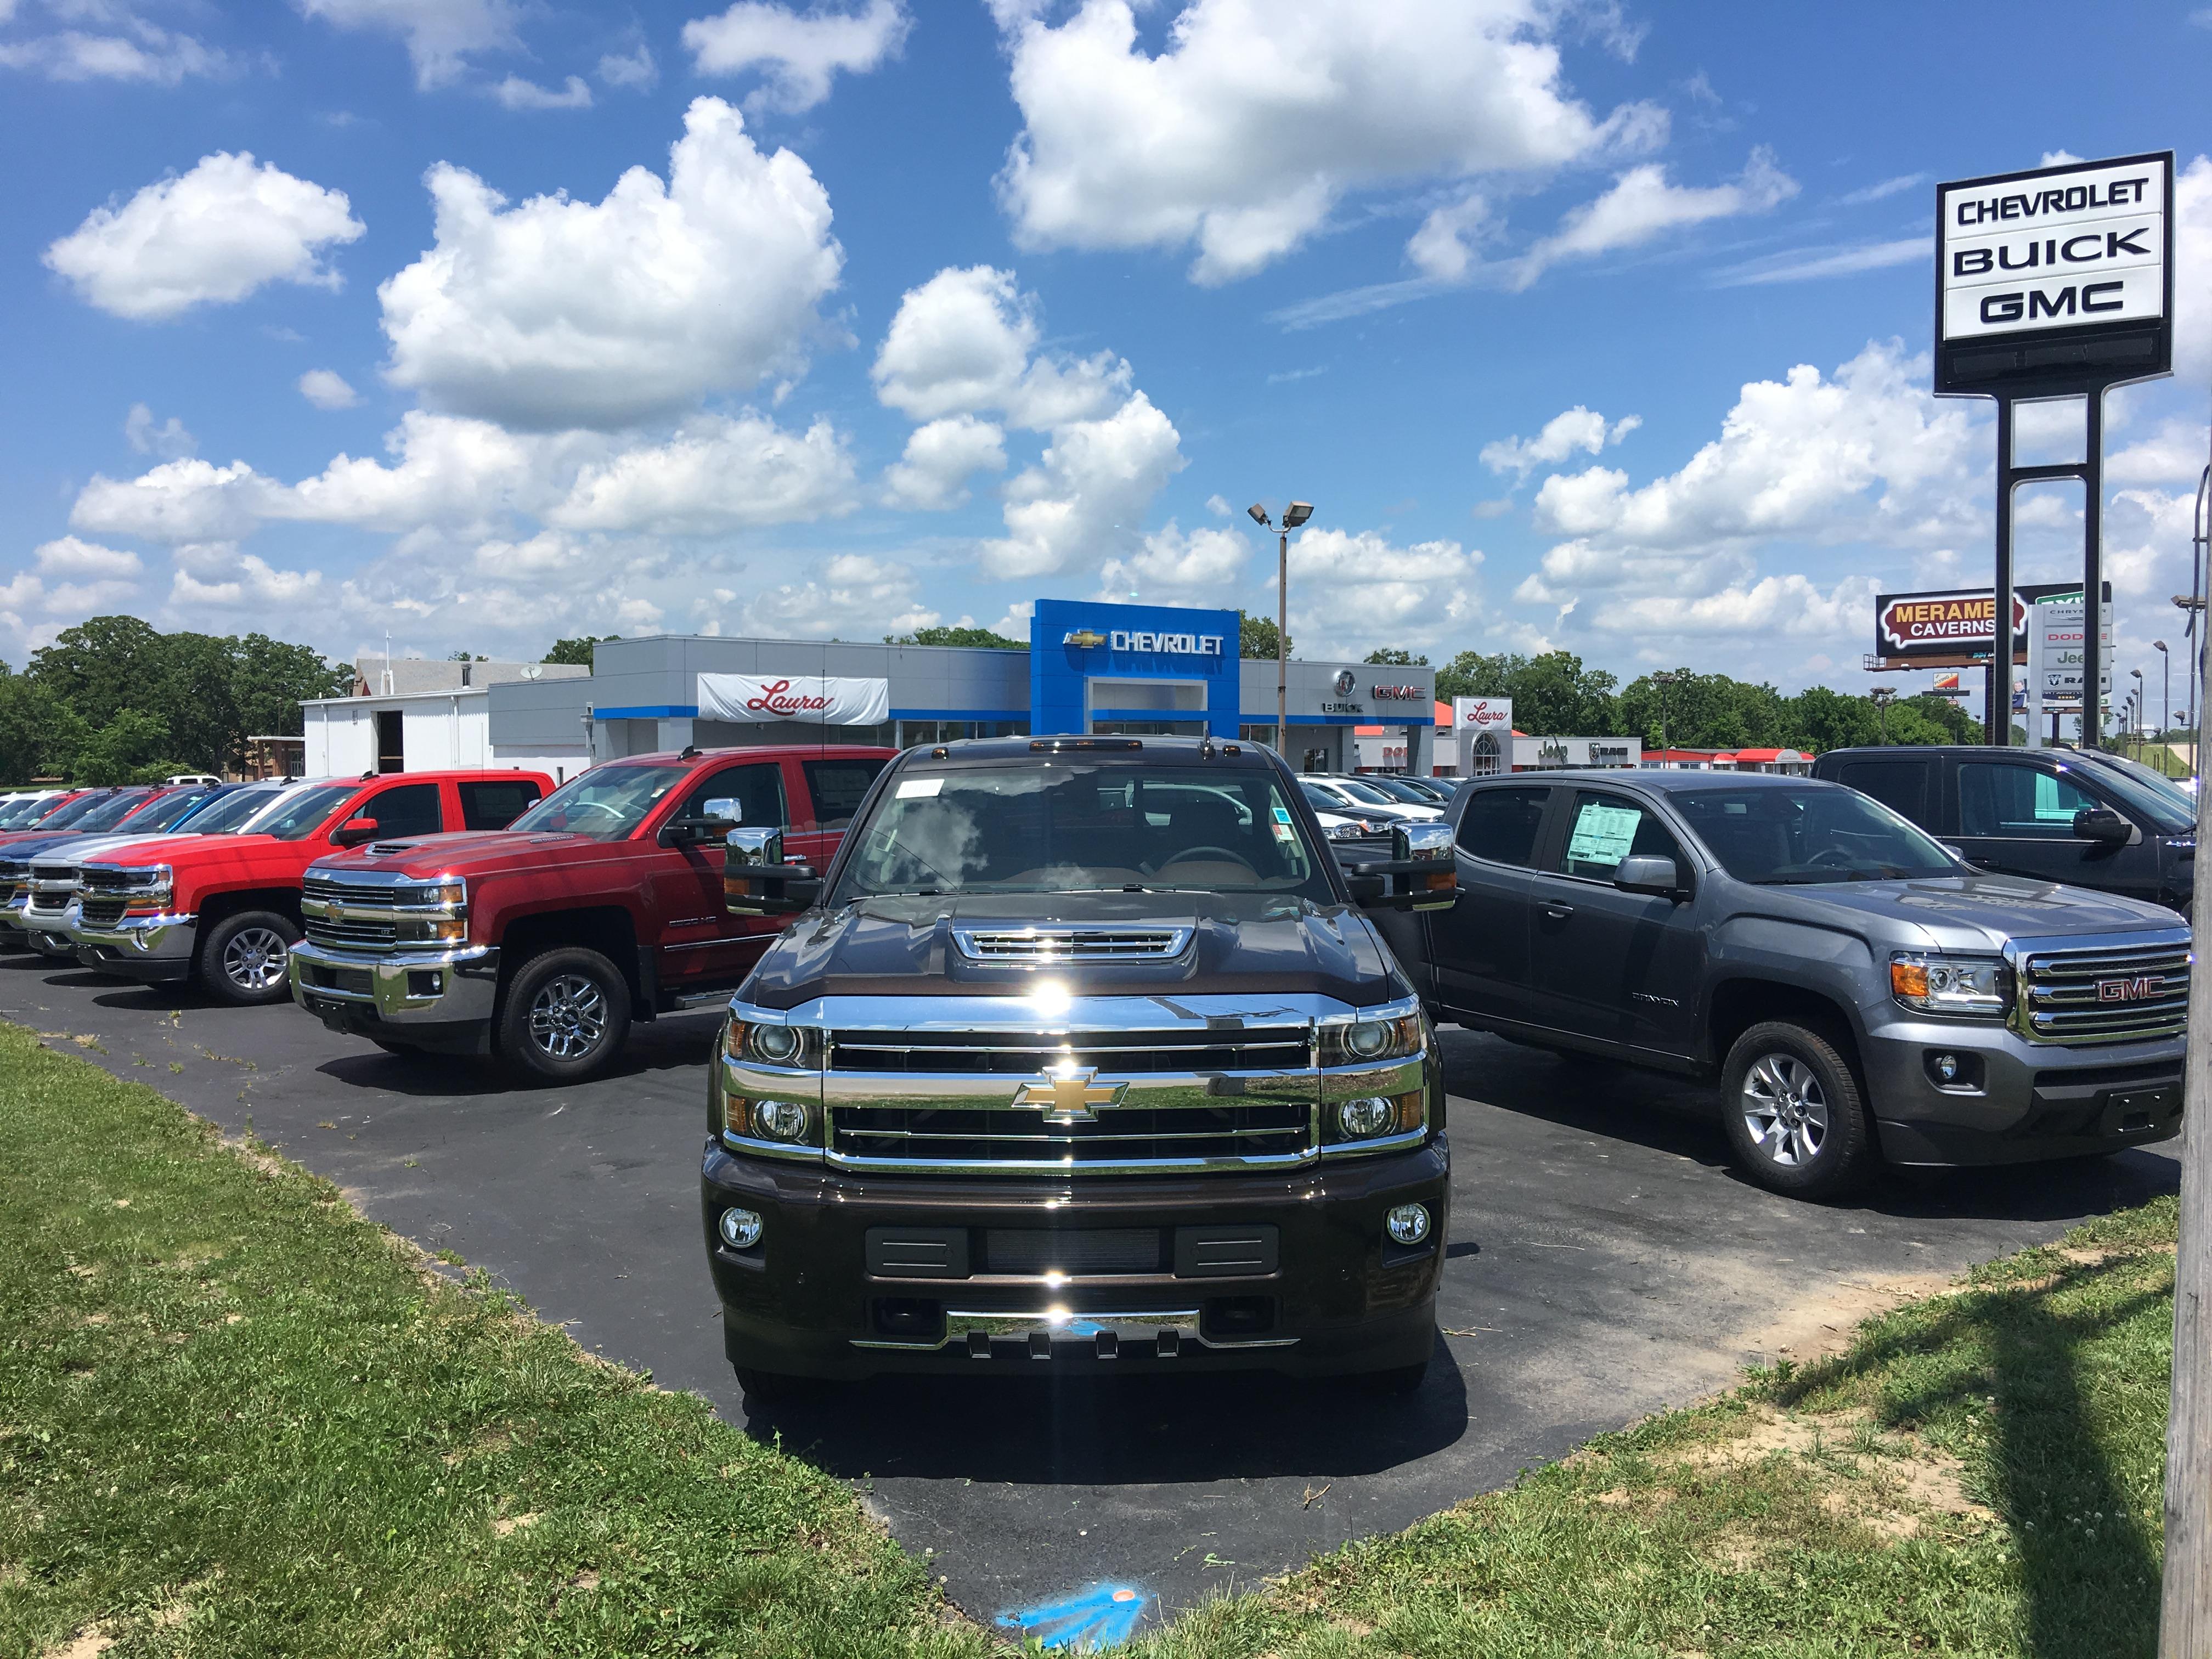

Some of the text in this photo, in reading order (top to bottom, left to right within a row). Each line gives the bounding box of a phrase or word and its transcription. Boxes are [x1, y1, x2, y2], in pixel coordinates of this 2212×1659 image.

[1957, 177, 2149, 225] CHEVROLET
[1954, 228, 2152, 276] BUICK
[1980, 280, 2124, 324] GMC
[1896, 601, 1995, 623] MERAME
[1910, 619, 1995, 636] CAVERNS
[1110, 631, 1224, 655] CHEVROLET
[2057, 651, 2084, 664] Jee
[747, 680, 835, 716] Laura
[1374, 685, 1426, 700] GMC
[1323, 703, 1364, 713] BUICK
[1467, 701, 1509, 725] Laura
[1538, 741, 1568, 758] Jeep
[2098, 975, 2165, 1002] GMC
